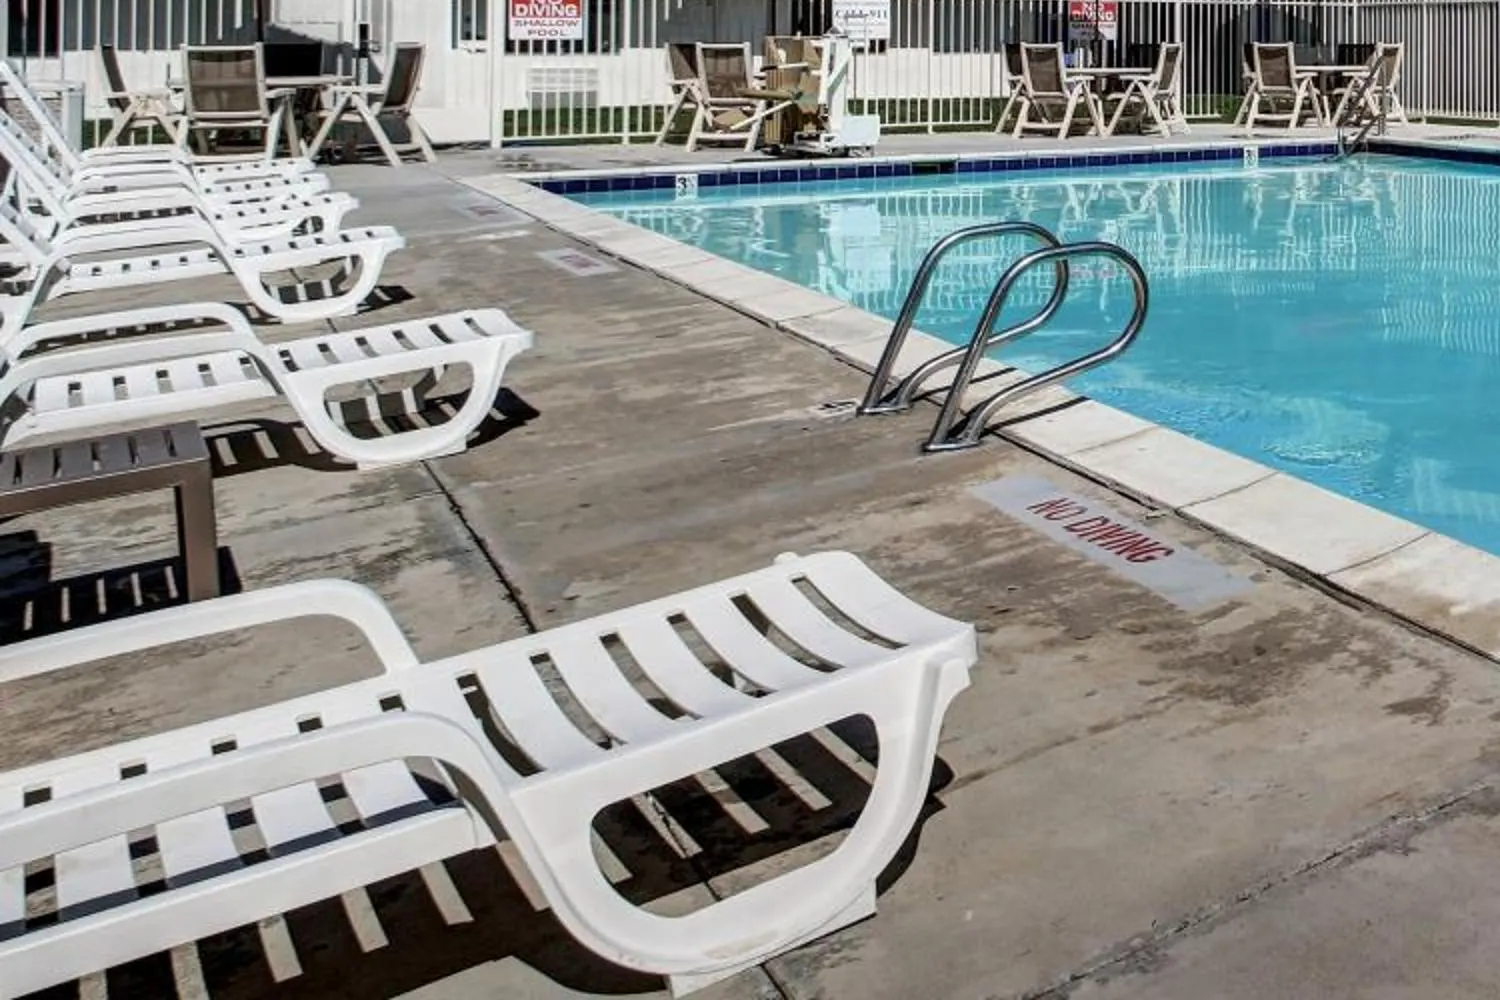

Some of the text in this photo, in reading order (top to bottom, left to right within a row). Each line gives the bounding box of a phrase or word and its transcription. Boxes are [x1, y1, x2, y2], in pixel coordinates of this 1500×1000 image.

[515, 3, 578, 17] DIVING
[514, 19, 580, 27] SHALLOW
[528, 29, 566, 37] POOL
[1025, 497, 1176, 563] NO DIVING
